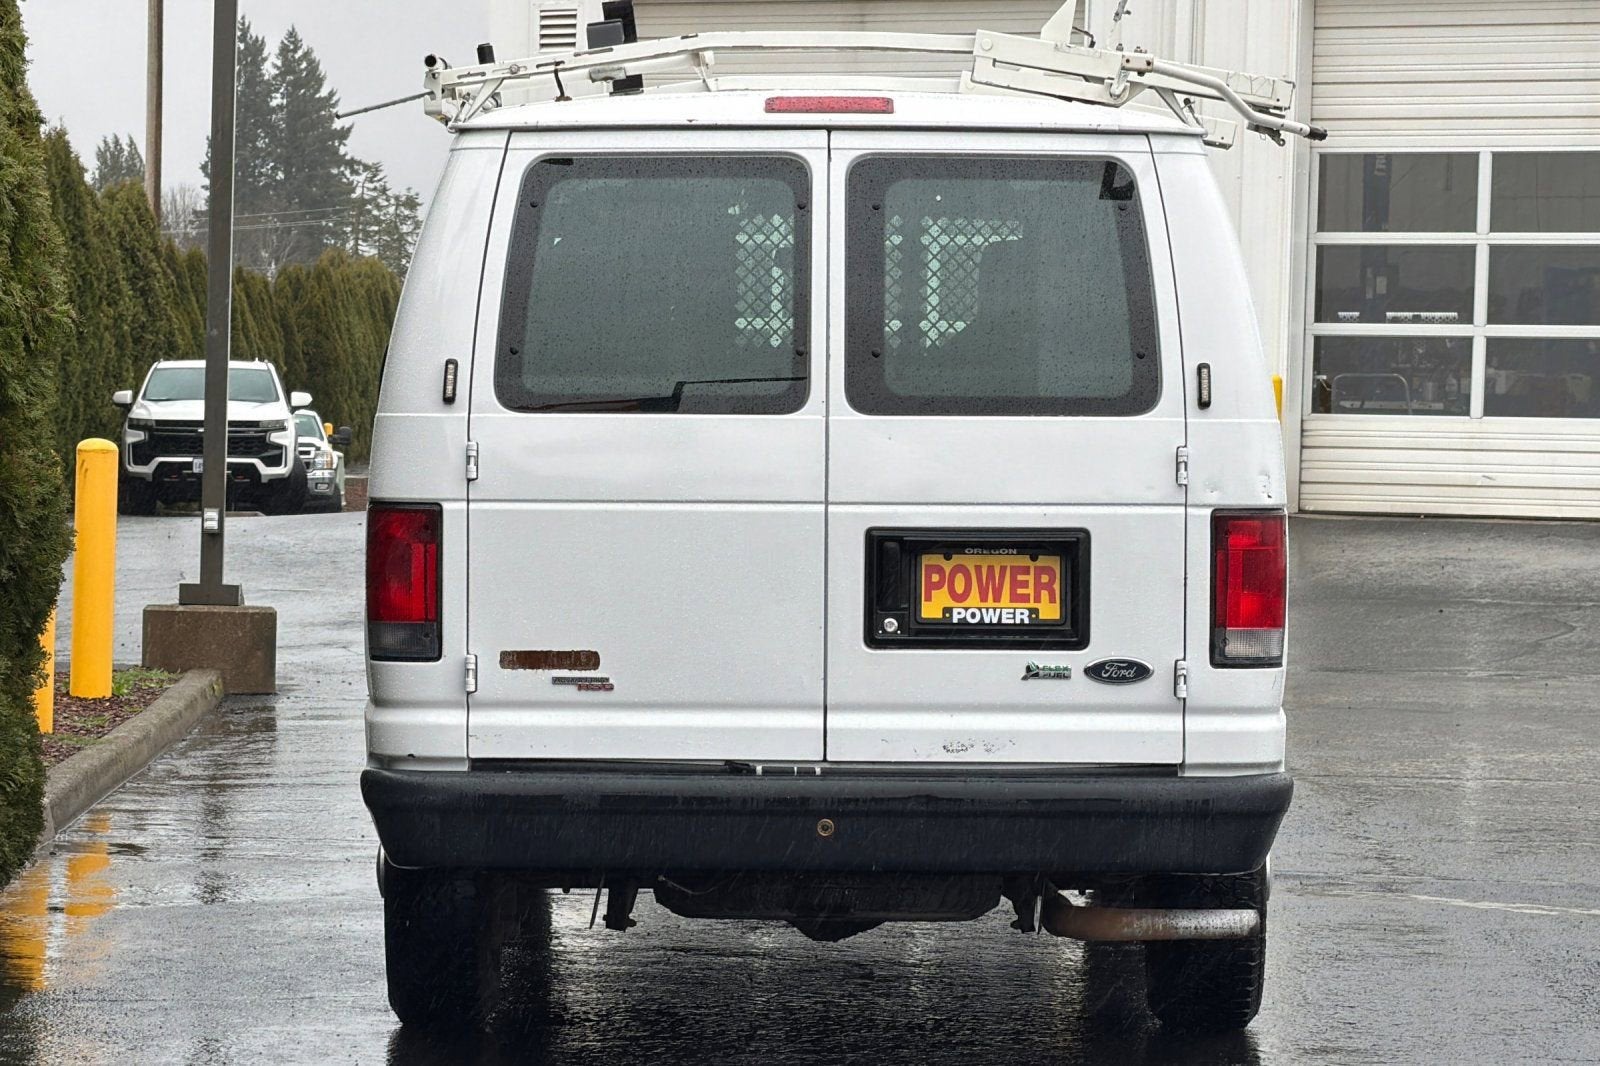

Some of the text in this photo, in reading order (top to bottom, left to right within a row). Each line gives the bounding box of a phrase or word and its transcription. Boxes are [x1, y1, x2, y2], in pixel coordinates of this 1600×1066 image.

[965, 547, 1017, 555] OREGON
[924, 563, 1057, 604] POWER
[952, 607, 1030, 624] POWER
[1101, 662, 1136, 678] Ford
